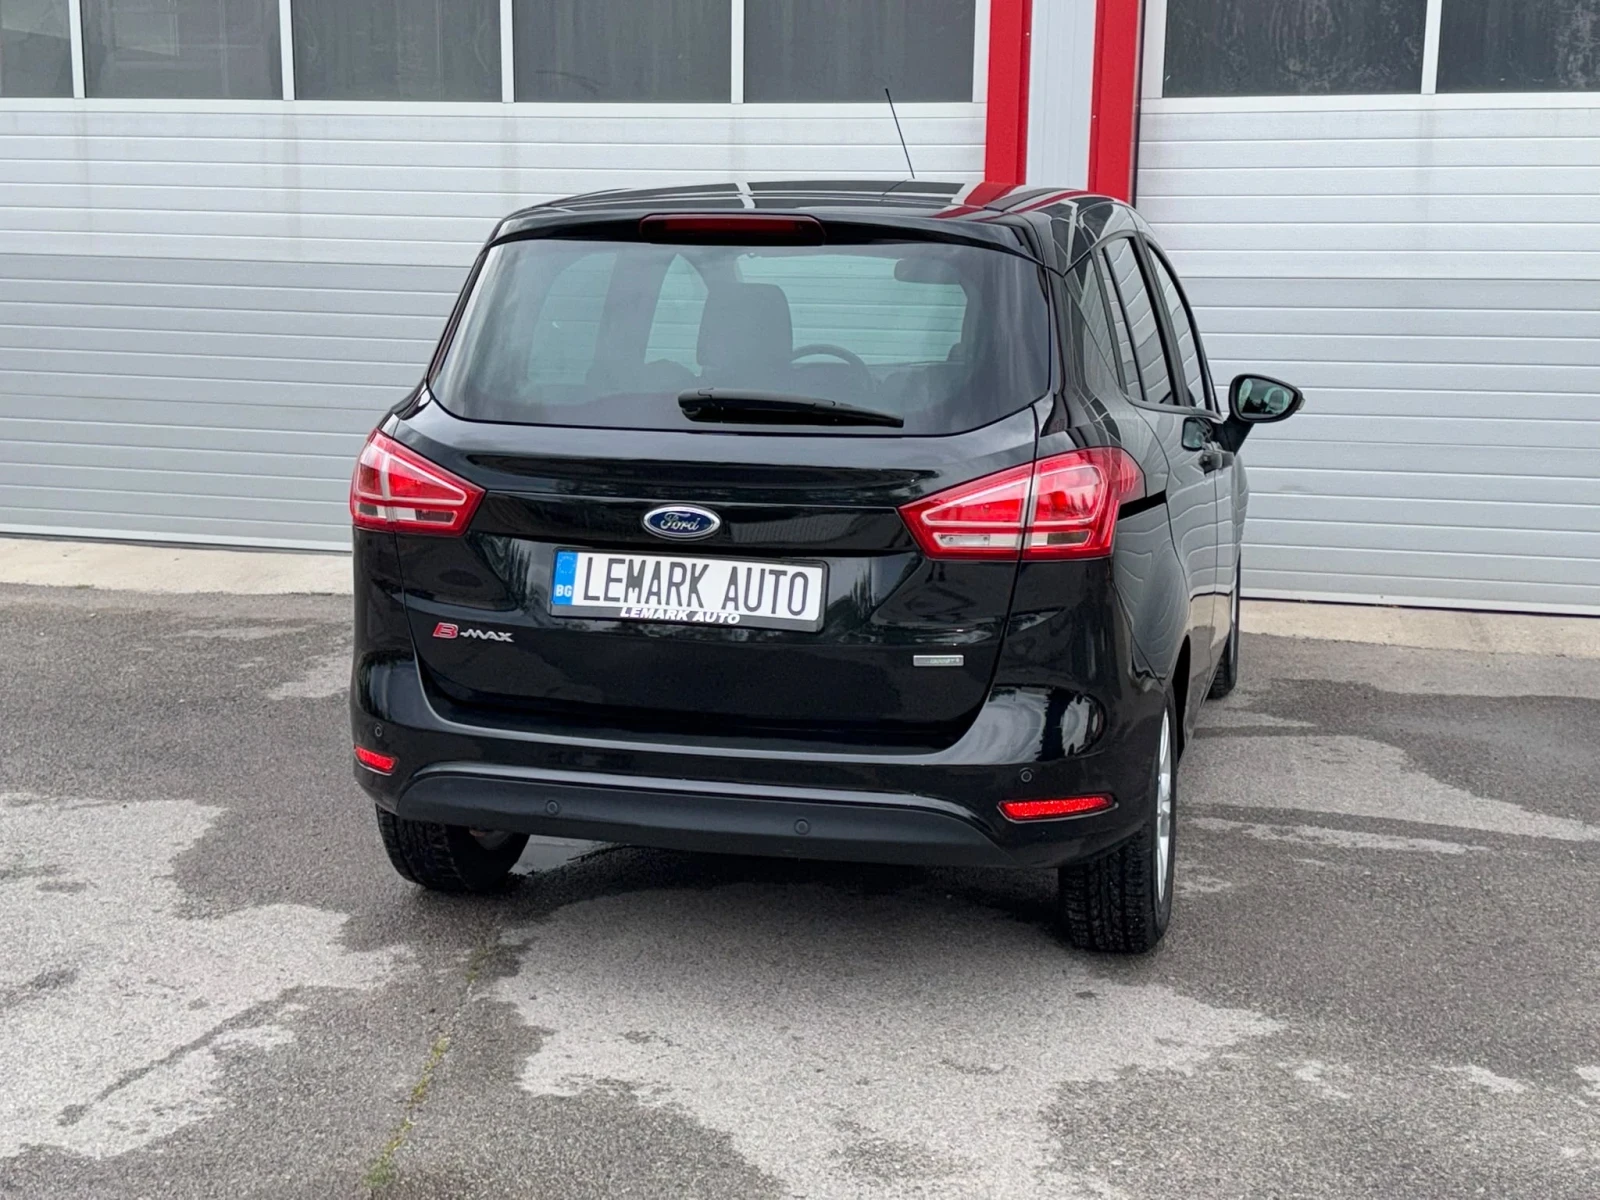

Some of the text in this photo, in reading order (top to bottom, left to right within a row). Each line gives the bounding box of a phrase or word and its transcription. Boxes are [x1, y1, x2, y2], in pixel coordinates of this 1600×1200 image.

[660, 512, 701, 531] Ford
[555, 584, 572, 598] BG
[583, 556, 809, 616] LEMARK AUTO
[619, 606, 740, 625] LEMARK AUTO
